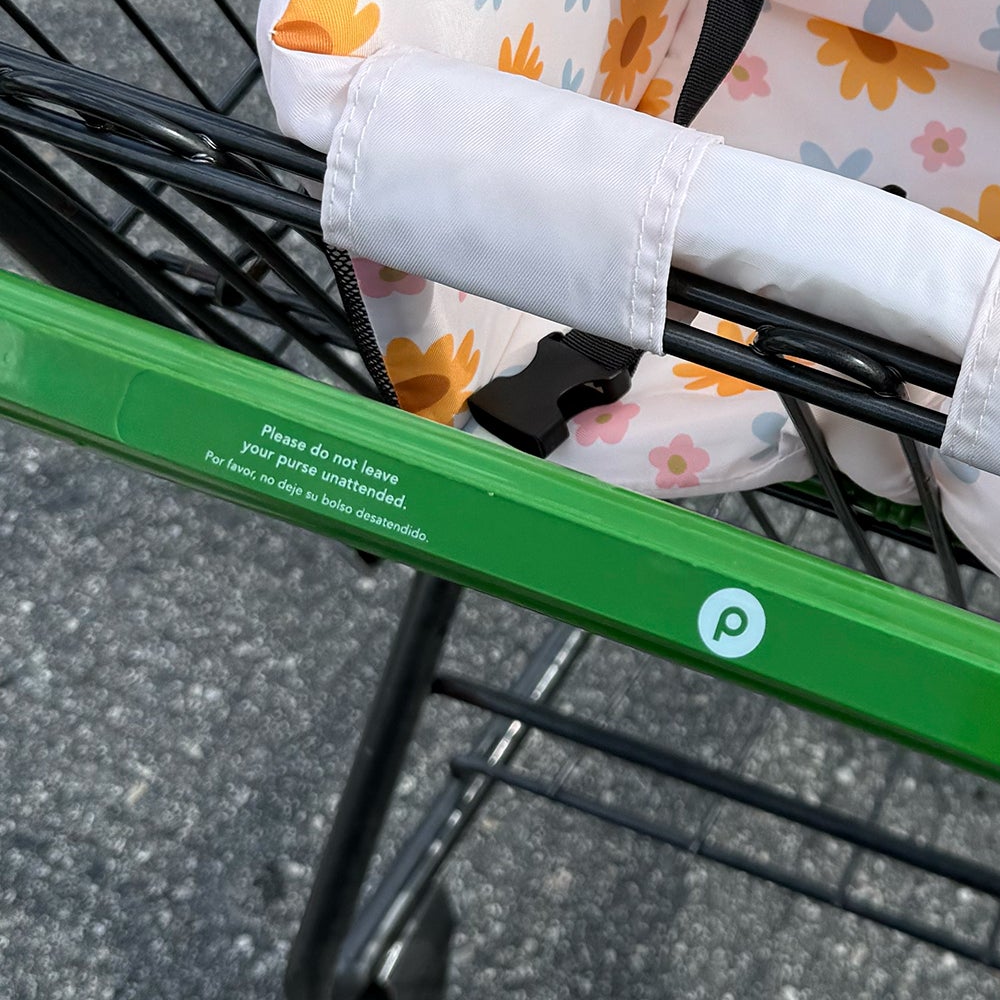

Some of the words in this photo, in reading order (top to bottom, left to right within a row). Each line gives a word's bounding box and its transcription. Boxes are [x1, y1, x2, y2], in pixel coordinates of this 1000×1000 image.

[240, 441, 275, 461] your
[276, 453, 318, 476] purse
[321, 468, 407, 510] unattended.
[261, 424, 306, 451] Please
[310, 444, 329, 460] do
[333, 453, 358, 470] not
[362, 460, 399, 485] leave
[204, 450, 225, 466] Por
[227, 458, 257, 480] favor,
[260, 468, 275, 485] no
[277, 478, 303, 496] deje
[305, 489, 319, 502] su
[321, 494, 353, 514] bolso
[356, 508, 429, 543] desatendido.
